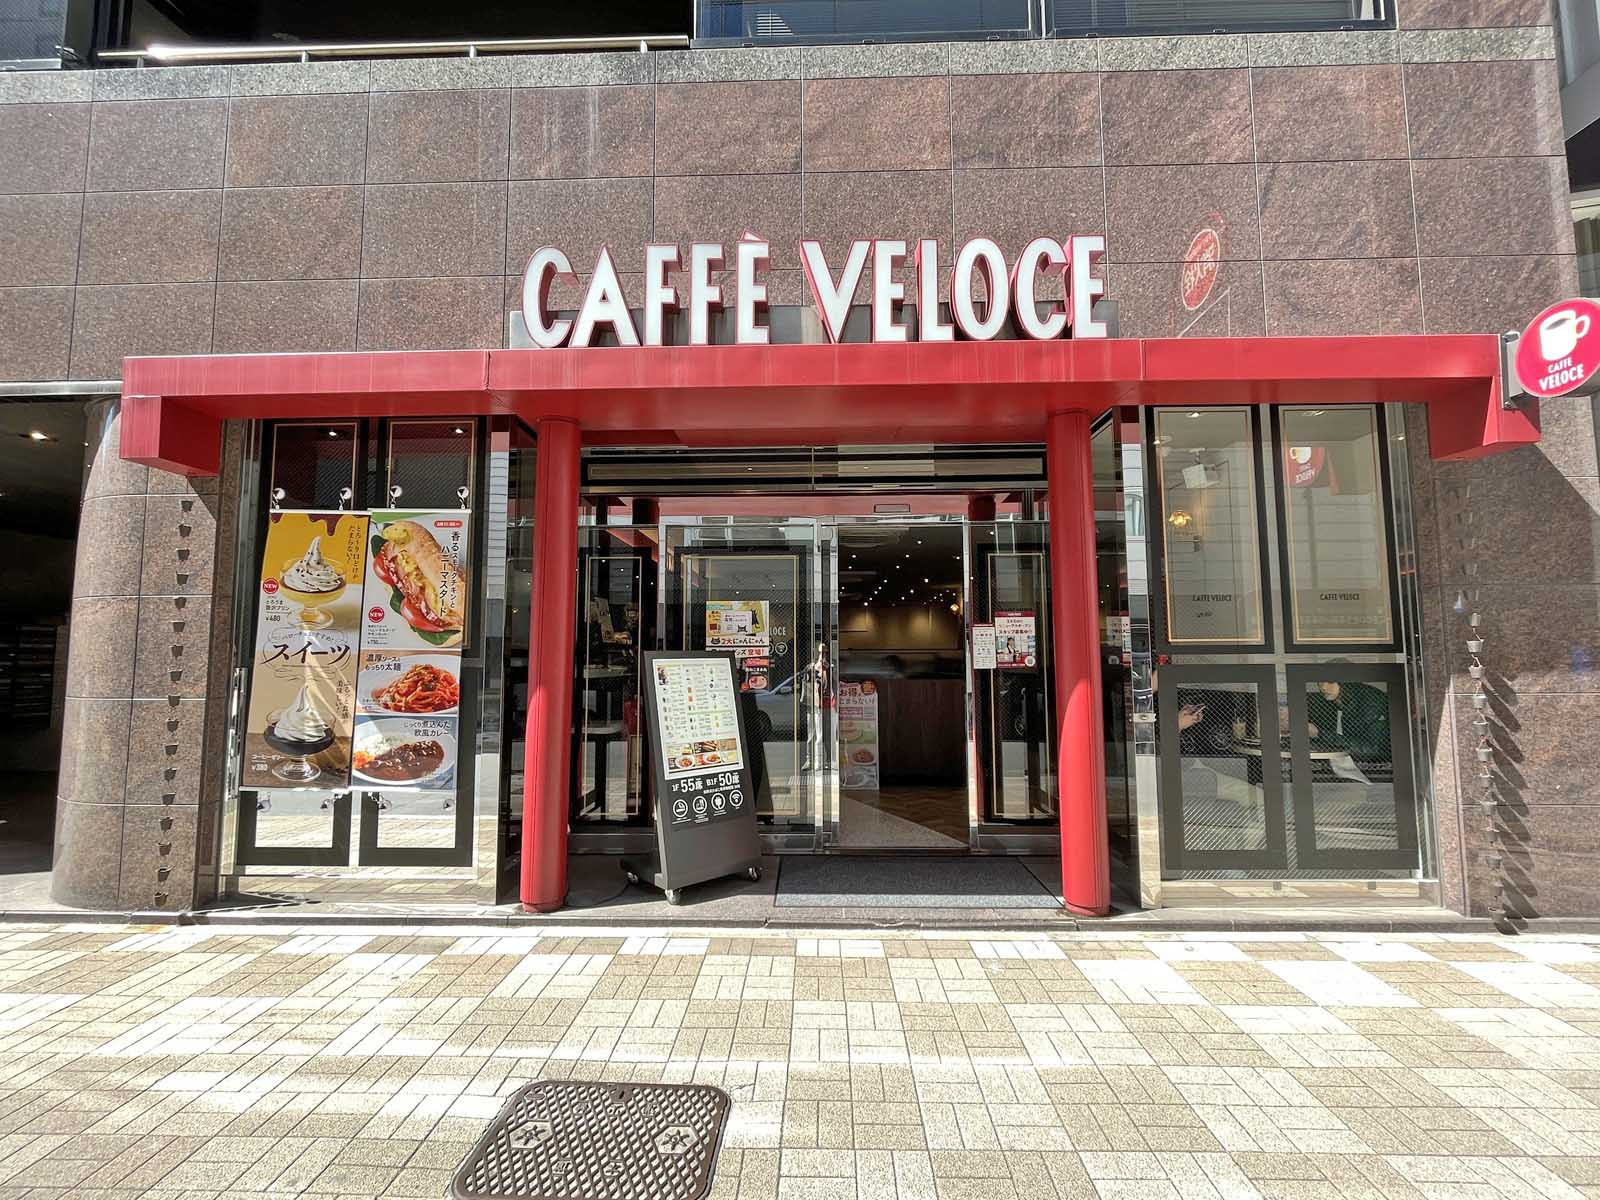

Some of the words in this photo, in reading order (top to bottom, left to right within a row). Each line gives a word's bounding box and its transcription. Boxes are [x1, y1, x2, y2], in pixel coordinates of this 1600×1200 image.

[521, 229, 771, 348] CAFFÈ
[800, 235, 1108, 343] VELOCE
[1538, 363, 1585, 391] VELOCE
[439, 545, 450, 617] ハニーマスタード
[450, 531, 461, 609] 香るスモークチキンと
[769, 626, 786, 635] LOCE
[260, 641, 350, 665] スイーツ
[414, 729, 449, 737] 欧風カレー
